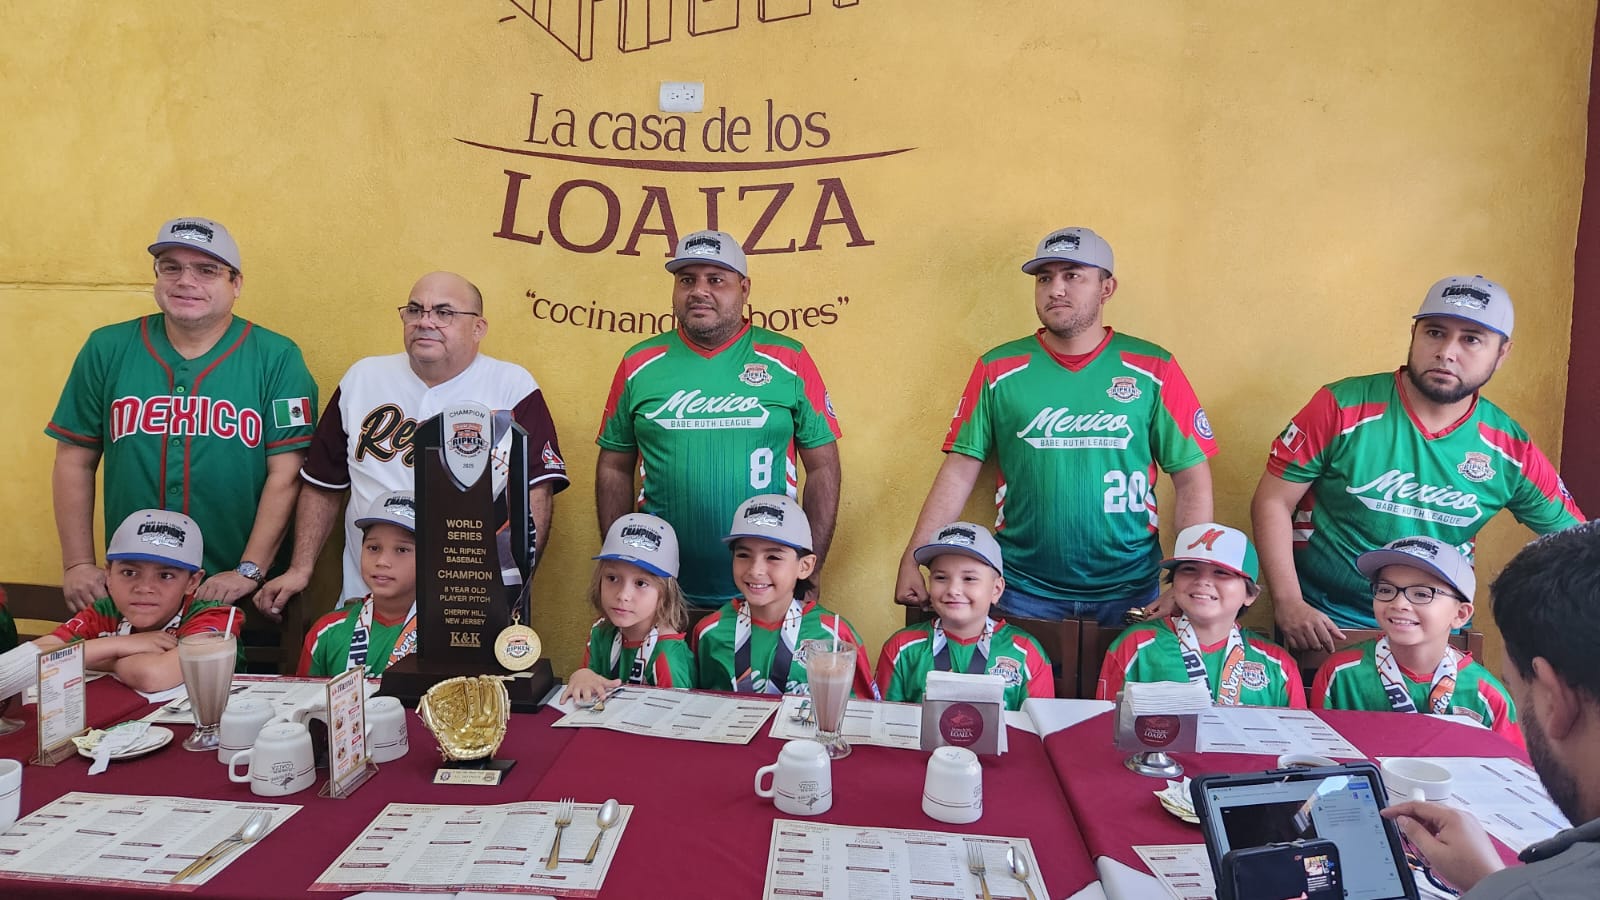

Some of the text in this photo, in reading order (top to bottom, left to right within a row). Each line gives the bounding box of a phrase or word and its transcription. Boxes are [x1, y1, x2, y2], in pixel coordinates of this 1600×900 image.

[524, 92, 831, 153] La casa de los
[493, 169, 875, 258] LOAIZA
[525, 289, 676, 334] “cocinand
[449, 408, 486, 419] CHAMPION
[645, 389, 760, 419] Mexico
[109, 395, 263, 448] MEXICO
[671, 418, 752, 428] BABE RUTH LEAGUE
[1016, 407, 1129, 438] Mexico
[452, 437, 484, 447] RIPKEN
[1040, 439, 1118, 447] BABE RUTH LEAGUE
[750, 447, 773, 489] 8
[1103, 470, 1147, 513] 20
[1346, 469, 1478, 509] Mexico
[1375, 501, 1462, 525] BABE RUTH LEAGUE
[137, 523, 186, 543] CHAMPIONS
[446, 519, 483, 529] WORLD
[447, 532, 482, 541] SERIES
[620, 526, 663, 547] CHAMPIONS
[1187, 528, 1225, 551] M
[443, 547, 458, 555] CAL
[446, 556, 483, 564] BASEBALL
[438, 569, 493, 580] CHAMPION
[439, 594, 490, 603] PLAYER PITCH
[443, 608, 470, 616] CHERRY
[445, 617, 460, 625] NEW
[393, 629, 417, 658] Serie
[450, 631, 481, 644] K&K
